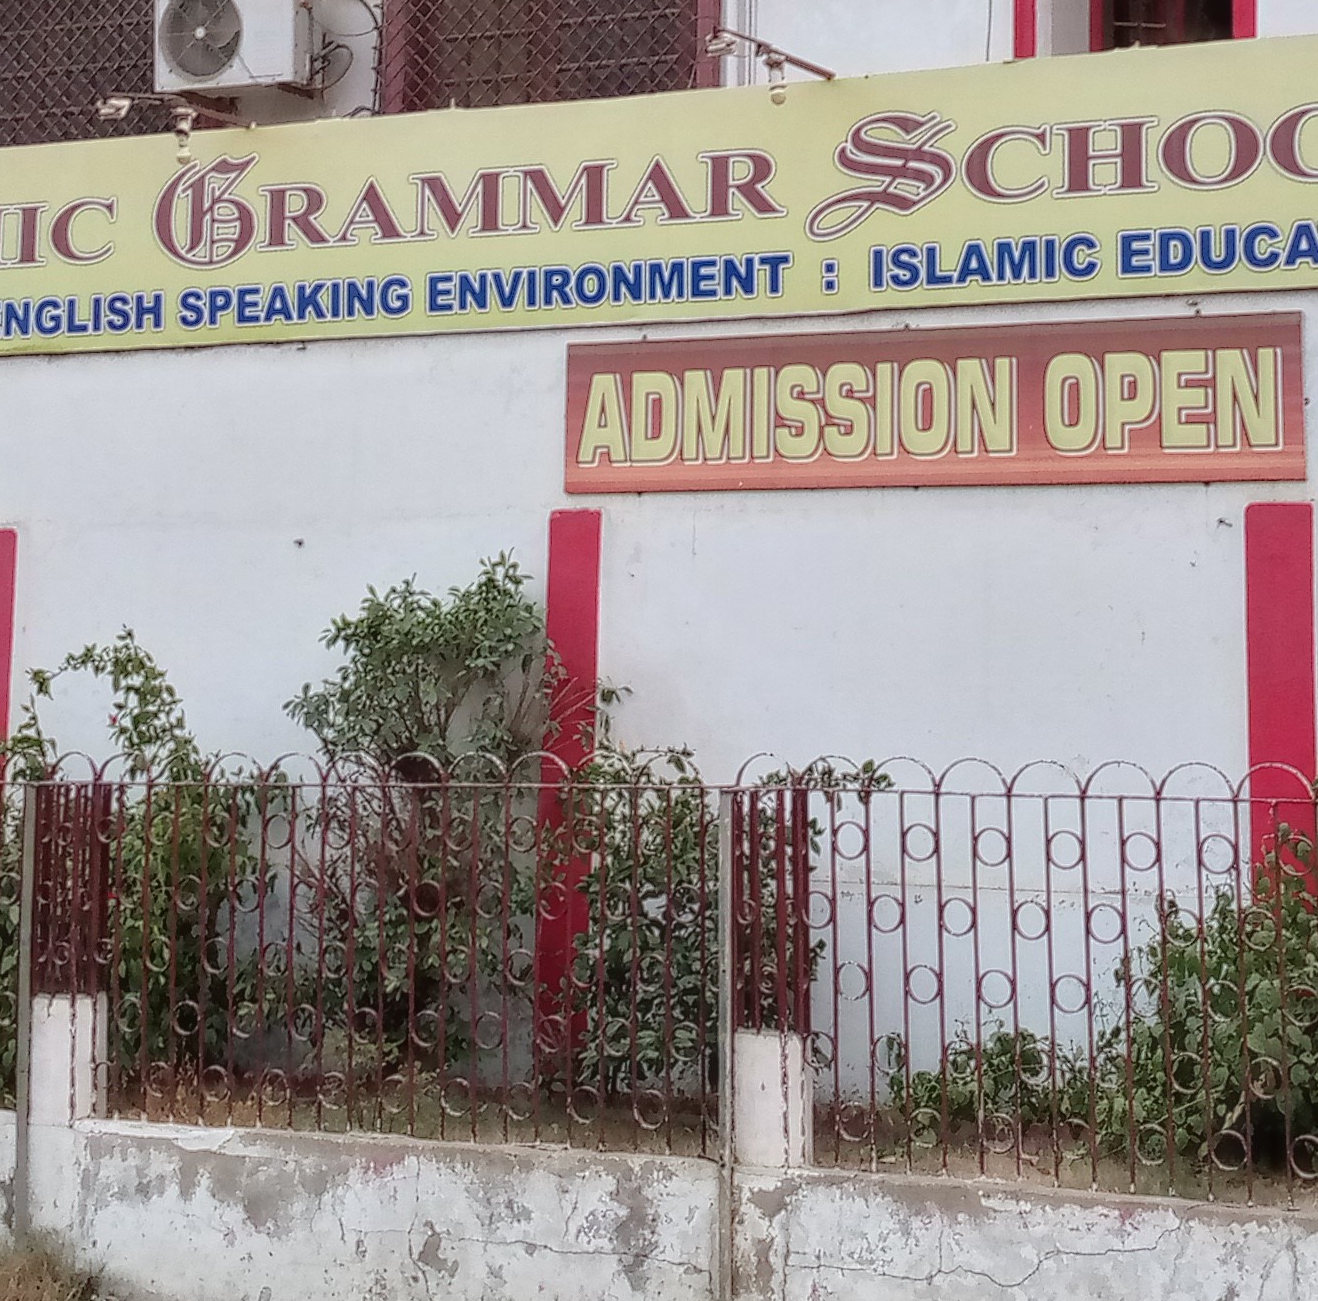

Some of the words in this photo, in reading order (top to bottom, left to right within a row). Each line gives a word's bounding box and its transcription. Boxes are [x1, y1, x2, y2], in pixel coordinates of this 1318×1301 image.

[177, 274, 412, 329] SPEAKING
[424, 252, 793, 318] ENVIRONMENT
[869, 235, 1100, 292] ISLAMIC
[576, 355, 1018, 468] ADMISSION
[1043, 346, 1282, 458] OPEN
